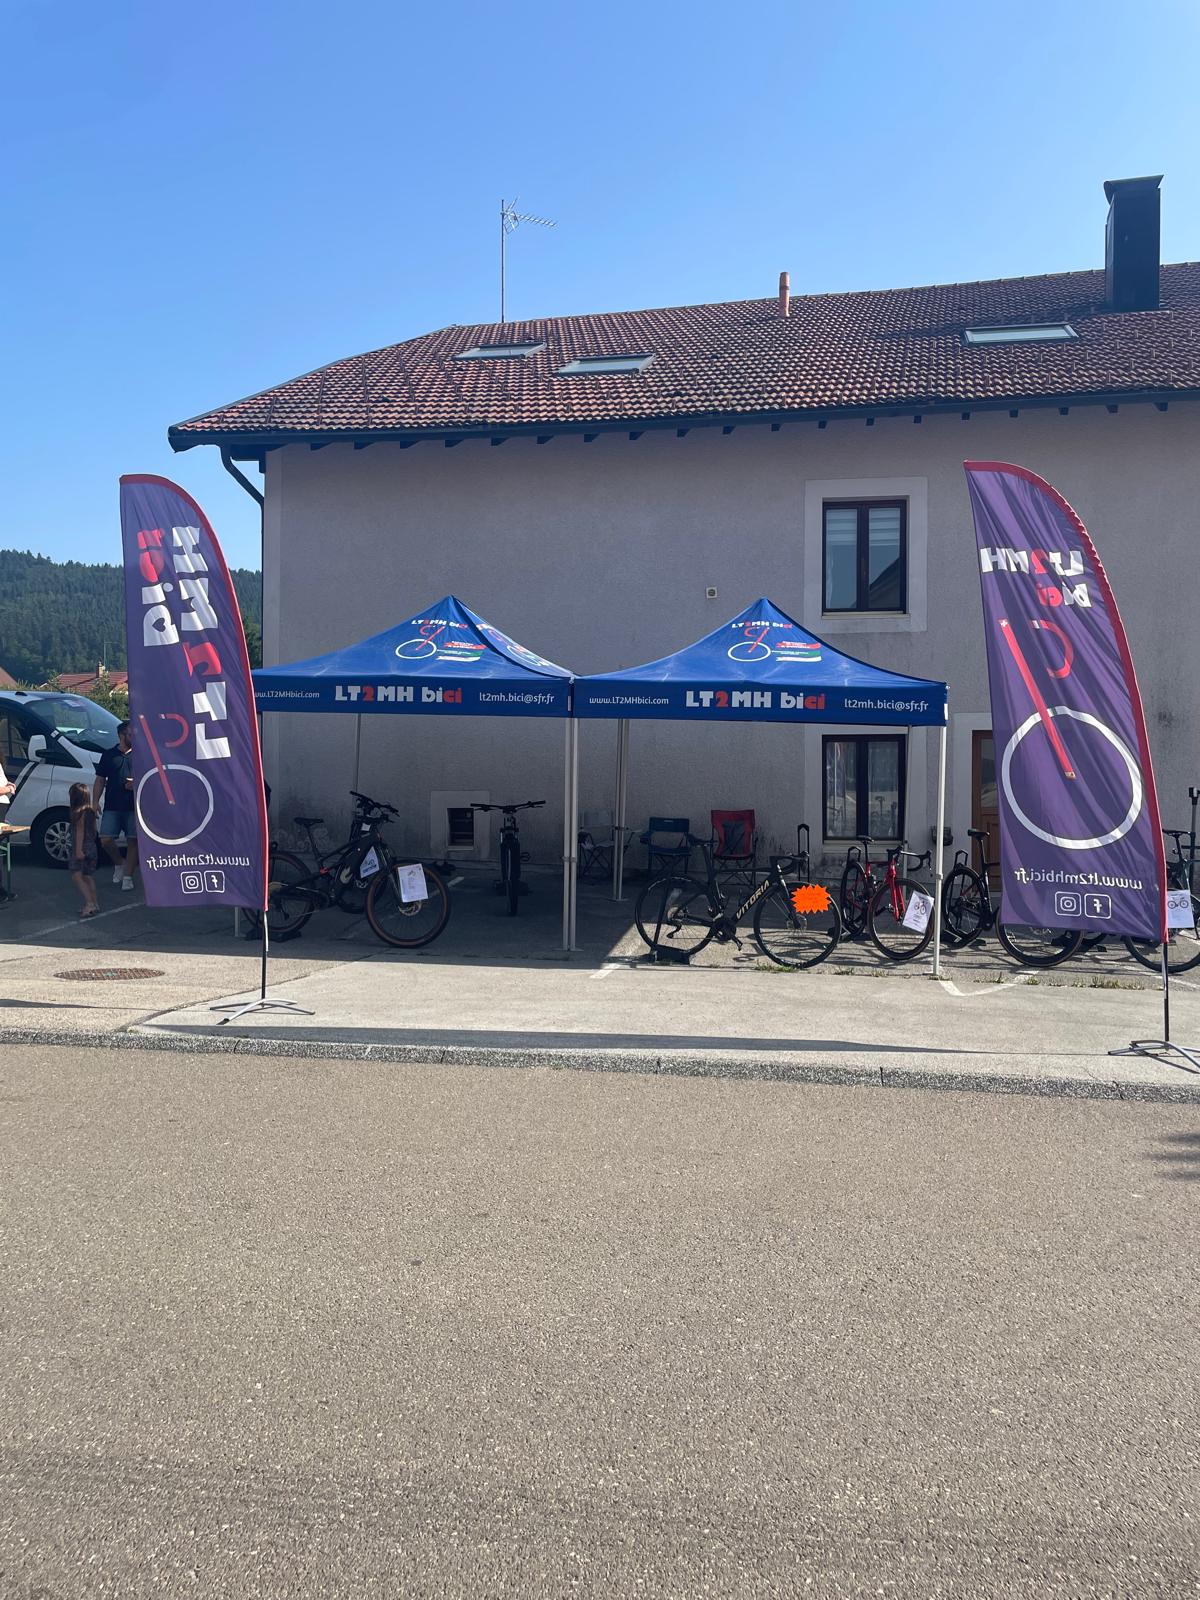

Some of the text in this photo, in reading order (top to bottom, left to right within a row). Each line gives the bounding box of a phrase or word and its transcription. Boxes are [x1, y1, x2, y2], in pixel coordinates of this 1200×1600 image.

[254, 690, 320, 699] ww.LT2MHbici.com
[335, 685, 463, 704] LT2MH bici
[479, 691, 555, 704] lt2mh.bici@sfr.fr
[589, 696, 669, 705] www.LT2MHbici.com
[685, 690, 826, 710] LT2MH bici
[844, 698, 929, 712] lt2mh.bici@sfr.fr
